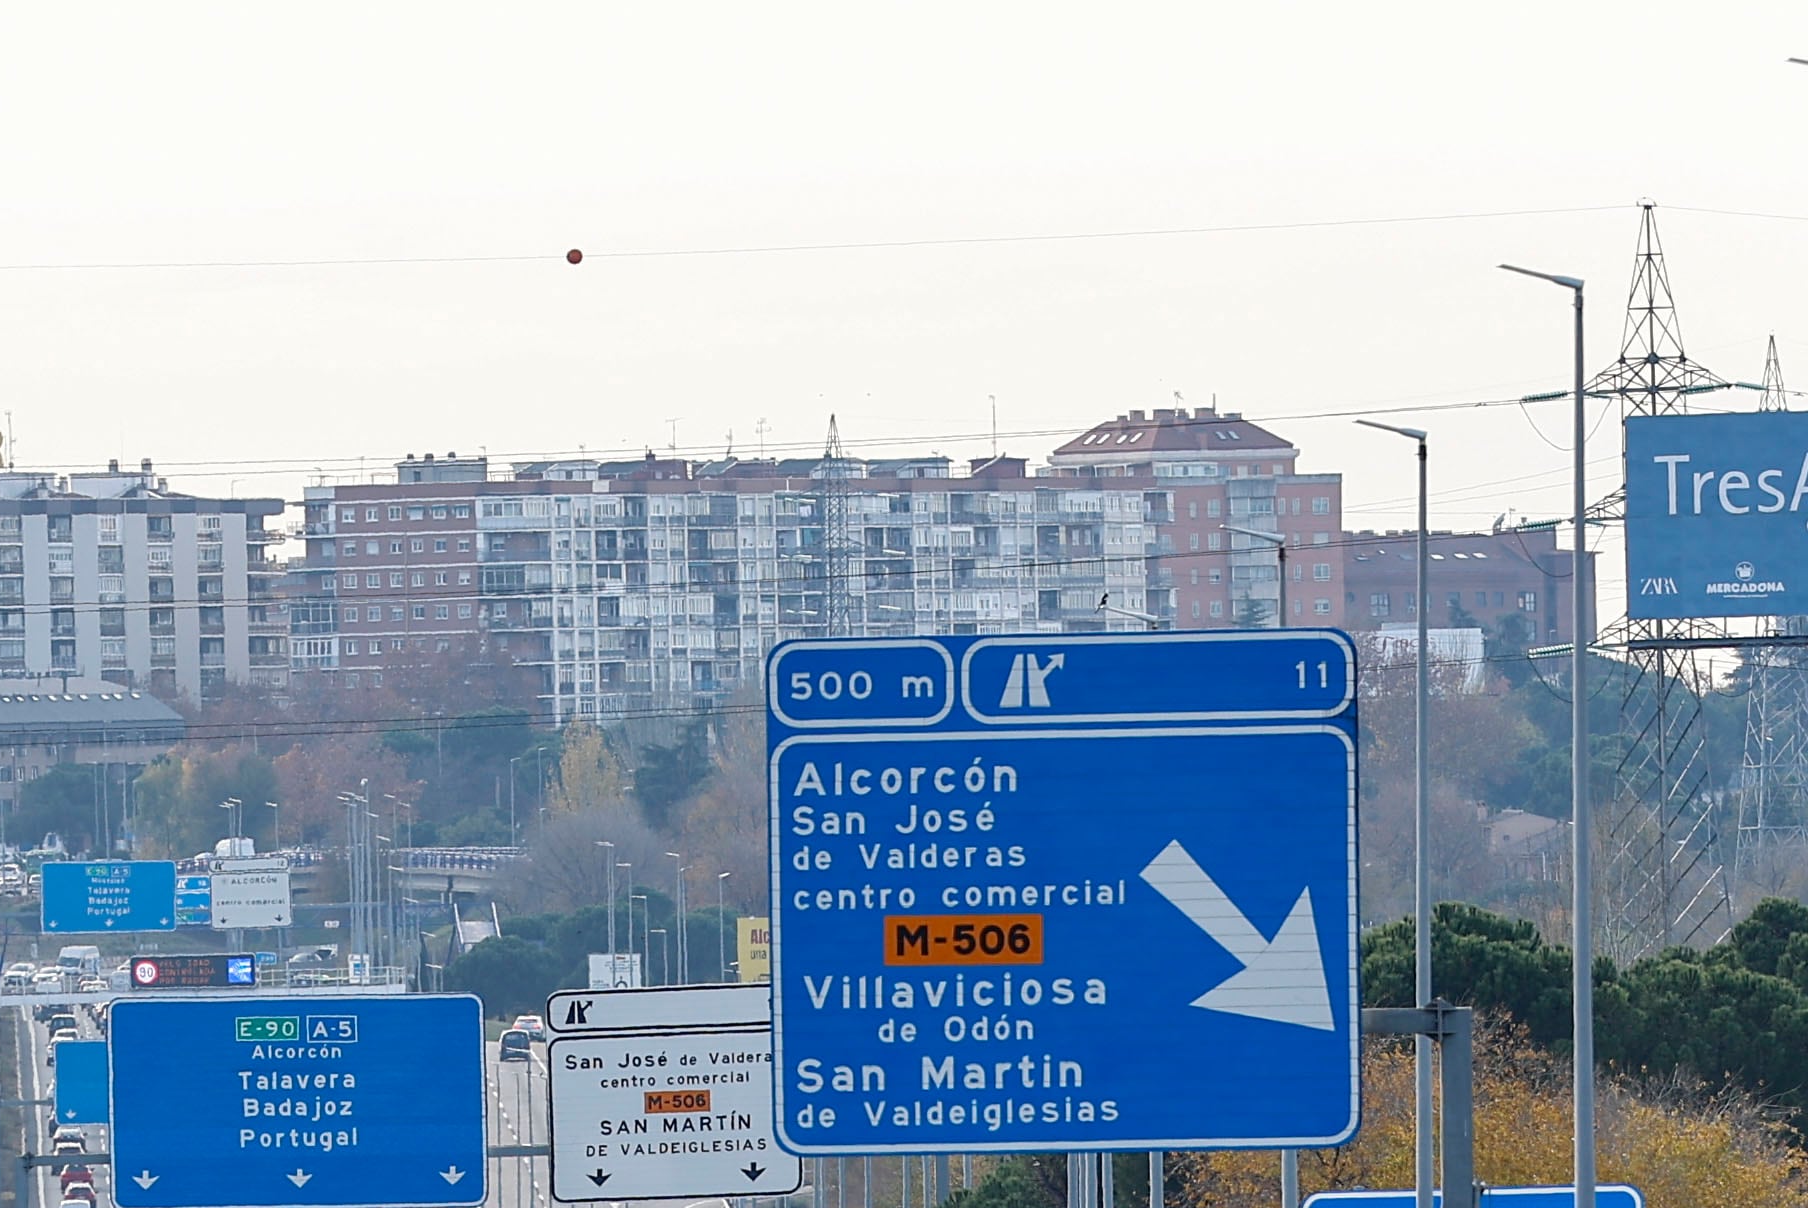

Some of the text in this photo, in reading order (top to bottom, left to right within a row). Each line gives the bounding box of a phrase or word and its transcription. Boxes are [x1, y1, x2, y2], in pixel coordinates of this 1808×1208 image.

[1640, 577, 1679, 595] ZARA
[1706, 582, 1785, 594] MERCADONA
[791, 671, 934, 700] 500 m
[1295, 661, 1327, 689] 11
[793, 757, 1017, 796] Alcorcón
[792, 801, 995, 835] San José
[793, 843, 1026, 870] de Valderas
[231, 876, 278, 886] ALCORCÓN
[88, 896, 129, 906] Badajoz
[793, 880, 1125, 910] centro comercial
[87, 906, 131, 917] Portugal
[751, 929, 769, 944] Alc
[895, 923, 1031, 956] M-506
[140, 967, 154, 977] 90
[804, 972, 1107, 1009] Villaviciosa
[240, 1021, 352, 1038] E-90 A-5
[878, 1014, 1034, 1043] de Odón
[252, 1044, 342, 1059] Alcorcón
[565, 1051, 772, 1070] San José de Valdera
[238, 1072, 356, 1090] Talavera
[601, 1071, 750, 1088] centro comercial
[796, 1058, 886, 1093] San
[243, 1096, 353, 1121] Badajoz
[647, 1094, 707, 1110] M-506
[600, 1111, 752, 1135] SAN MARTÍN
[796, 1096, 1119, 1132] de Valdeiglesias
[239, 1127, 358, 1152] Portugal
[586, 1138, 767, 1157] DE VALDEIGLESIAS
